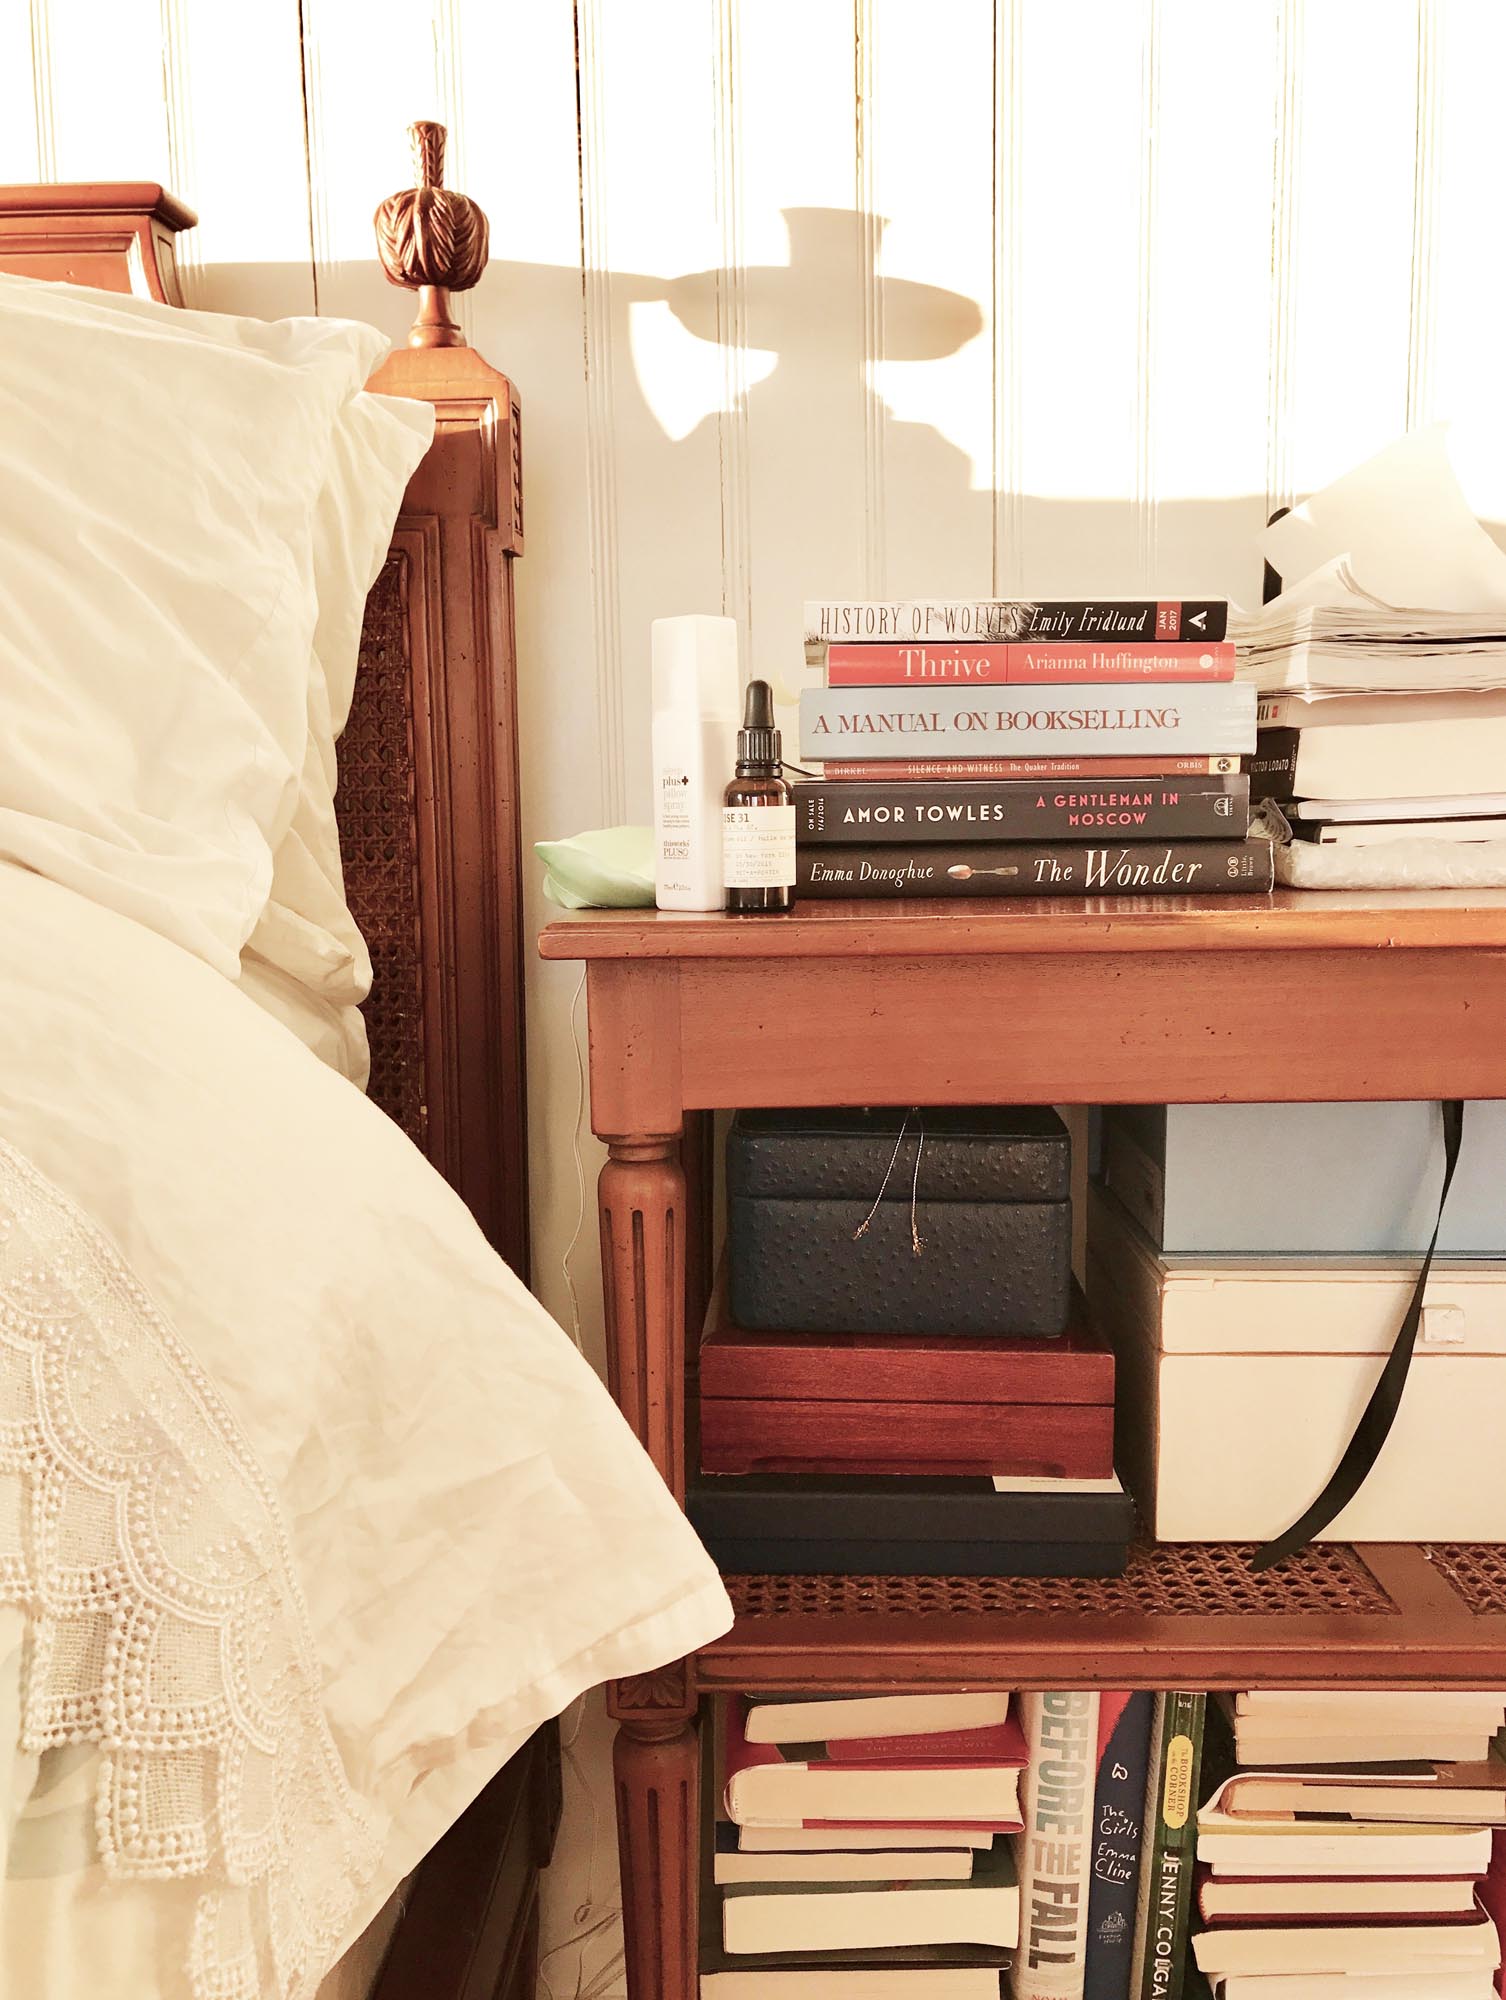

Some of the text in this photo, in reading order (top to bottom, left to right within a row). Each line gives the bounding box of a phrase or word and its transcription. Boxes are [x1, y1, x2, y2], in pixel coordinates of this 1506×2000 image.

[821, 606, 1019, 635] HISTORY OF WOLVES
[1029, 606, 1148, 637] Emily Fridlund
[1158, 611, 1167, 630] JAN
[1168, 610, 1178, 631] 2017
[899, 649, 991, 678] Thrive
[1024, 652, 1179, 674] Arianna Huffington
[812, 708, 1182, 735] A MANUAL ON BOOKSELLING
[907, 763, 1003, 774] SILENCE AND WITNESS
[1009, 762, 1080, 773] The Quaker Tradition
[1176, 761, 1203, 770] ORBIS
[1036, 792, 1179, 808] A GENTLEMAN IN
[738, 813, 750, 823] 31
[843, 804, 1005, 823] AMOR TOWLES
[1069, 812, 1147, 826] MOSCOW
[808, 821, 815, 830] ON
[810, 860, 934, 888] Emma Donoghue
[1034, 850, 1202, 887] The Wonder
[1036, 1692, 1090, 1835] BEFORE
[1167, 1766, 1179, 1812] CORNER
[1176, 1758, 1189, 1818] BOOKSHOP
[1102, 1805, 1125, 1817] The
[1100, 1814, 1139, 1839] Girls
[1032, 1839, 1081, 1876] THE
[1097, 1843, 1136, 1861] Emma
[1095, 1858, 1132, 1880] Cline
[1028, 1879, 1080, 1970] FALL
[1152, 1851, 1180, 2000] JENNY COLGA
